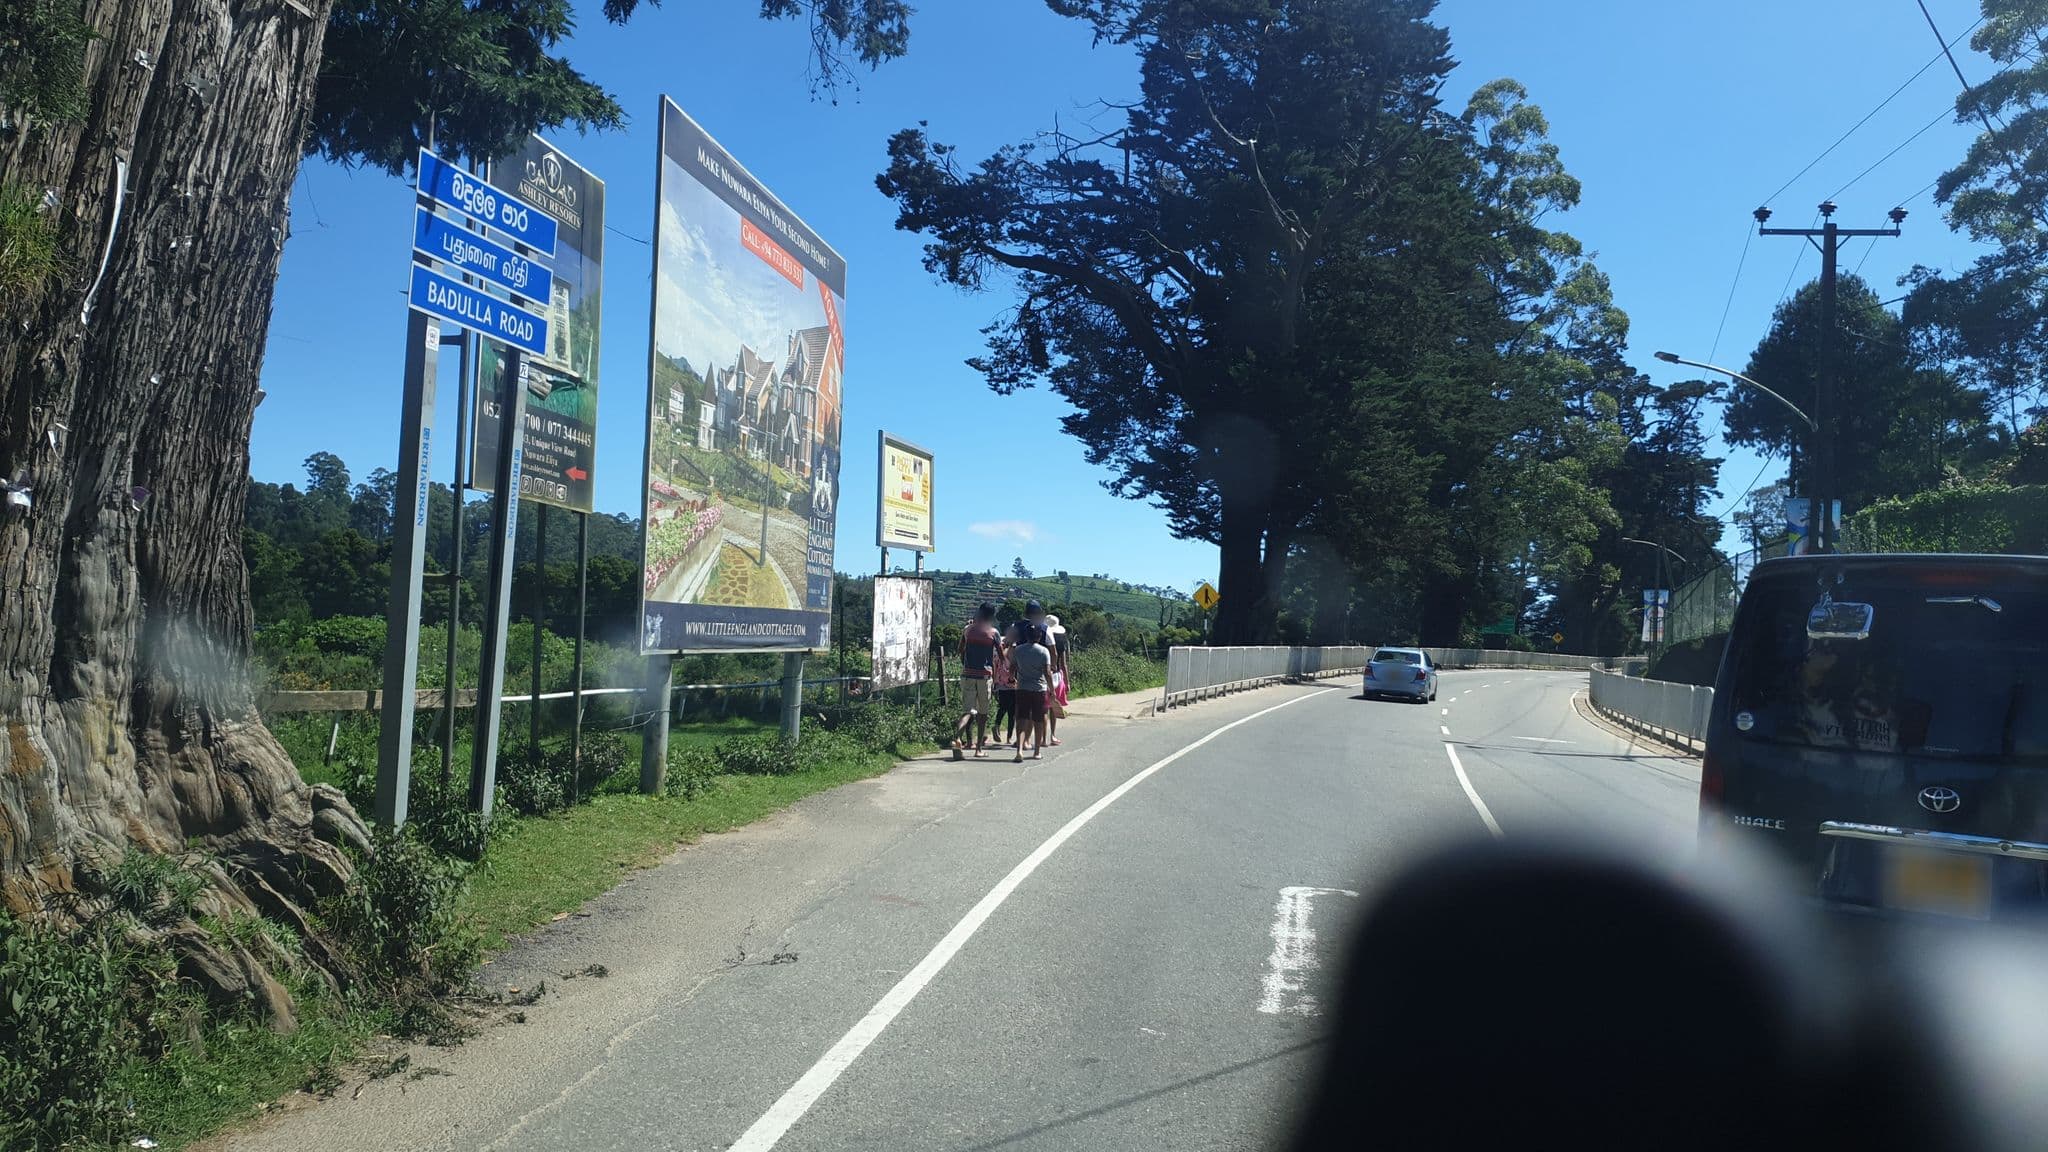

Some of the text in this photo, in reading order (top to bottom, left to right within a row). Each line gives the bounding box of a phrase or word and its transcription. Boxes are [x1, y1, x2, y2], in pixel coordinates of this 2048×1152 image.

[518, 182, 582, 228] ASHLEY RESORTS
[697, 146, 720, 178] MAKE
[721, 167, 752, 205] NUWARA
[770, 208, 788, 237] YOUR
[788, 225, 810, 254] SECOND
[502, 203, 529, 232] පාර
[443, 232, 529, 289] பதுளை வீதி
[427, 281, 534, 342] BADULLA ROAD
[525, 414, 541, 431] 700
[547, 422, 561, 438] 077
[417, 442, 431, 527] RICHARDSON
[507, 462, 520, 539] RICHARDSON
[809, 516, 833, 535] LITTLE
[808, 531, 833, 550] ENGLAND
[807, 547, 832, 566] COTTAGES
[685, 621, 807, 636] WWW.LITTLEENGLANDCOTTAGES.COM
[1733, 814, 1786, 831] HIACE
